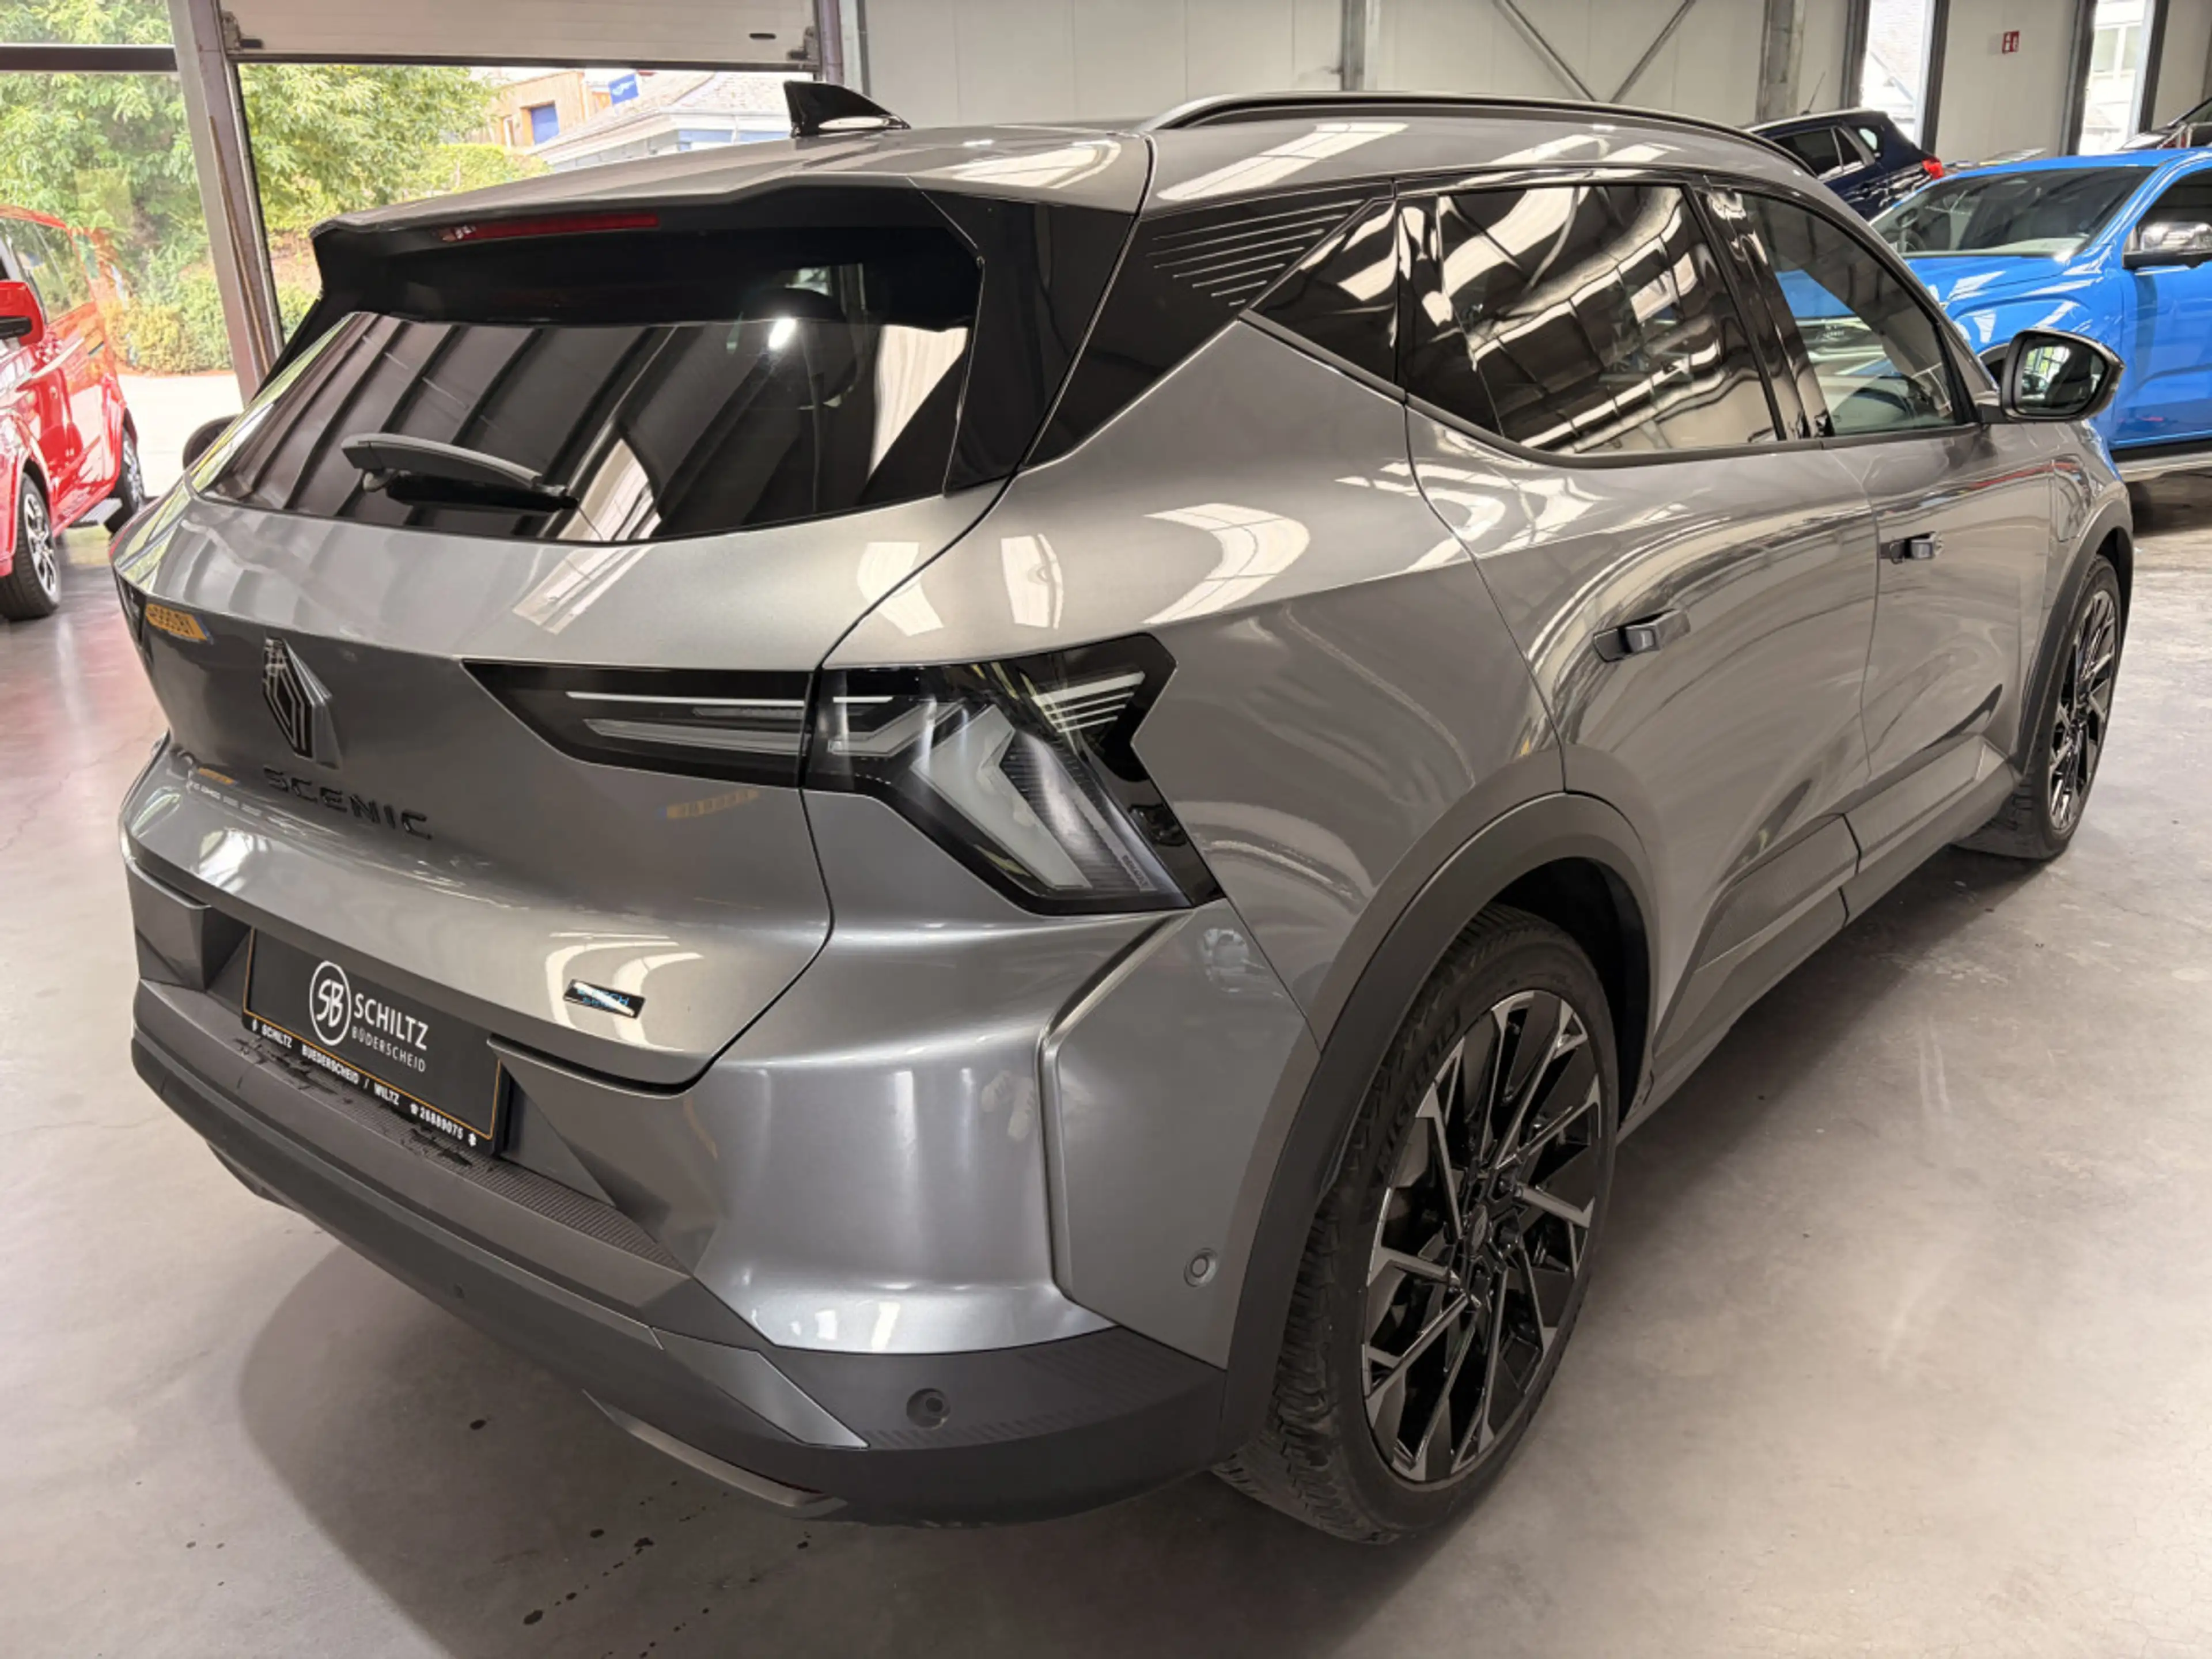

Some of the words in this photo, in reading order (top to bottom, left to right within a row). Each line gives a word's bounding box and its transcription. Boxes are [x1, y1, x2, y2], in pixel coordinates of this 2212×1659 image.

[263, 765, 432, 839] SCENIC
[354, 993, 429, 1051] SCHILTZ
[262, 1023, 293, 1048] SCHILTZ
[302, 1044, 360, 1085] BUEDERSCHEID
[374, 1082, 399, 1106] WILTZ
